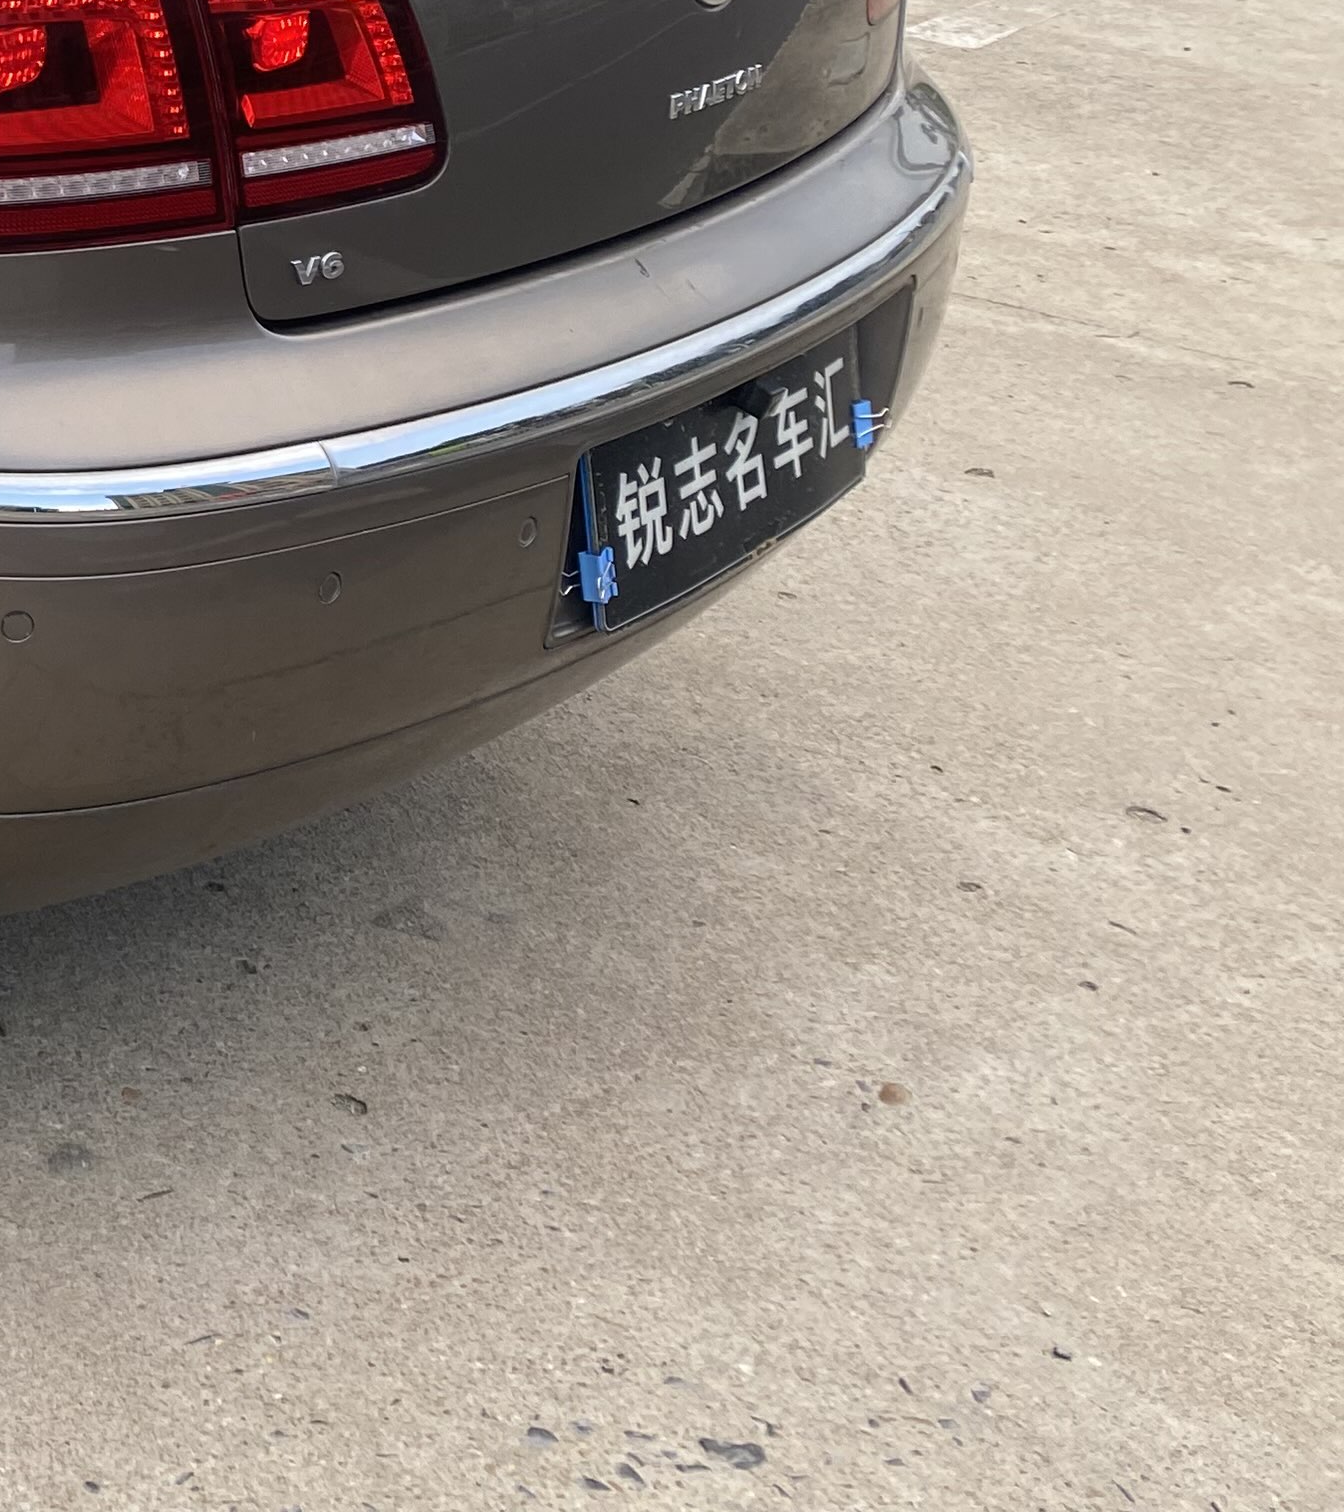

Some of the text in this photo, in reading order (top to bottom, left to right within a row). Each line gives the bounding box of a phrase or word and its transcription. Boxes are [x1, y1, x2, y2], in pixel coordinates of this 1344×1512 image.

[669, 63, 763, 120] PHAETON
[291, 251, 345, 286] V6
[616, 357, 850, 570] 锐志名车汇
